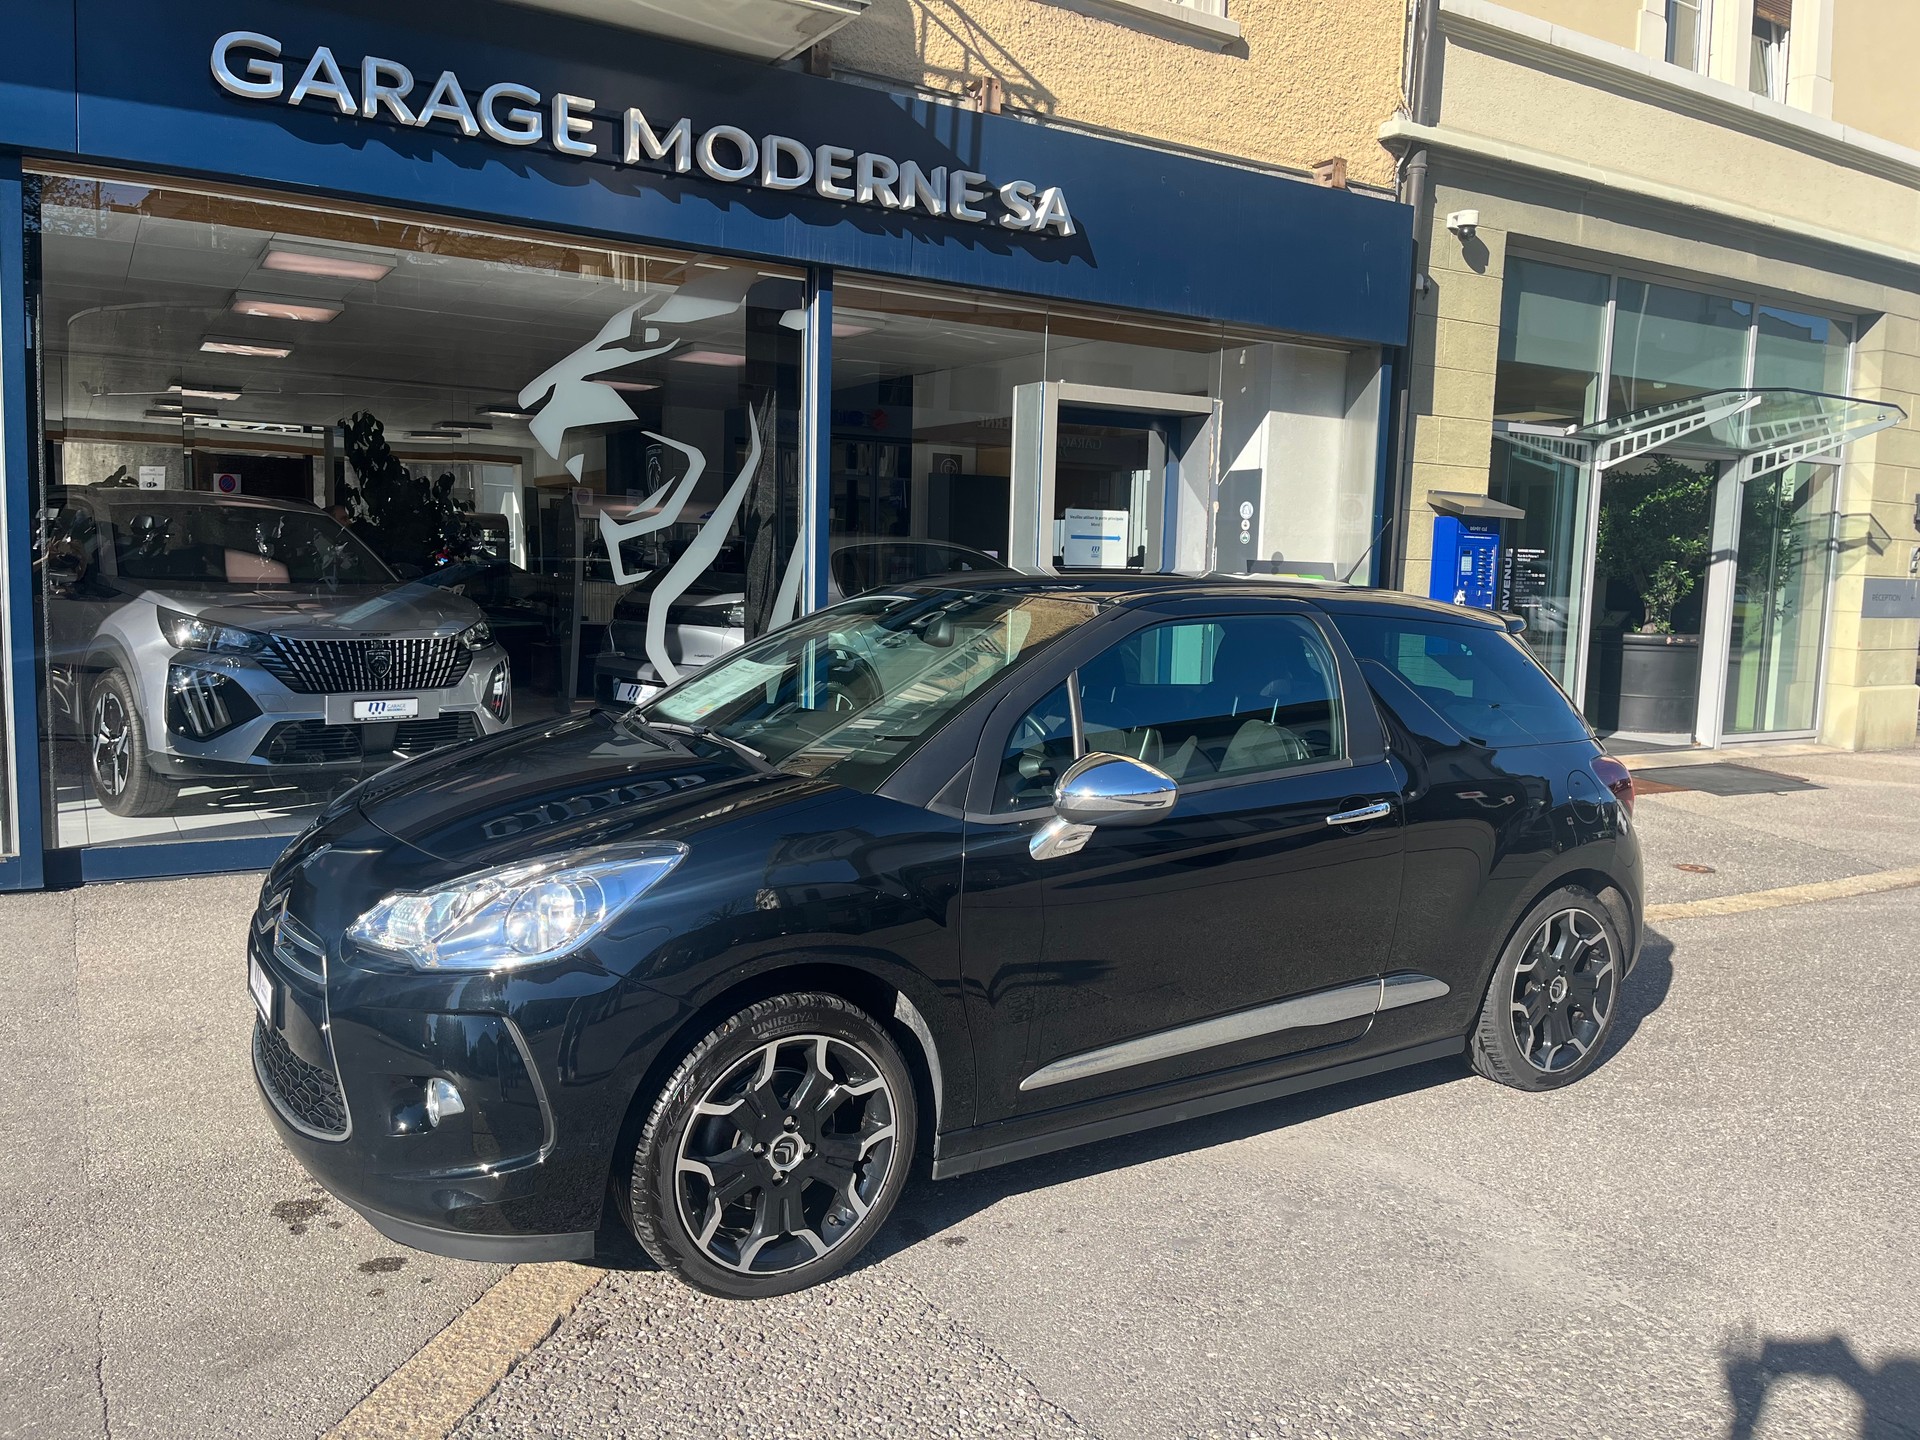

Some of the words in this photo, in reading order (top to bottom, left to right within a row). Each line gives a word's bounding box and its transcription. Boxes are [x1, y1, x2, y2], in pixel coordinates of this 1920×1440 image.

[210, 30, 597, 157] GARAGE
[623, 106, 987, 221] MODERNE
[999, 180, 1077, 237] SA
[1872, 592, 1901, 602] RÉCEPTION
[751, 1011, 823, 1035] UNIROYAL
